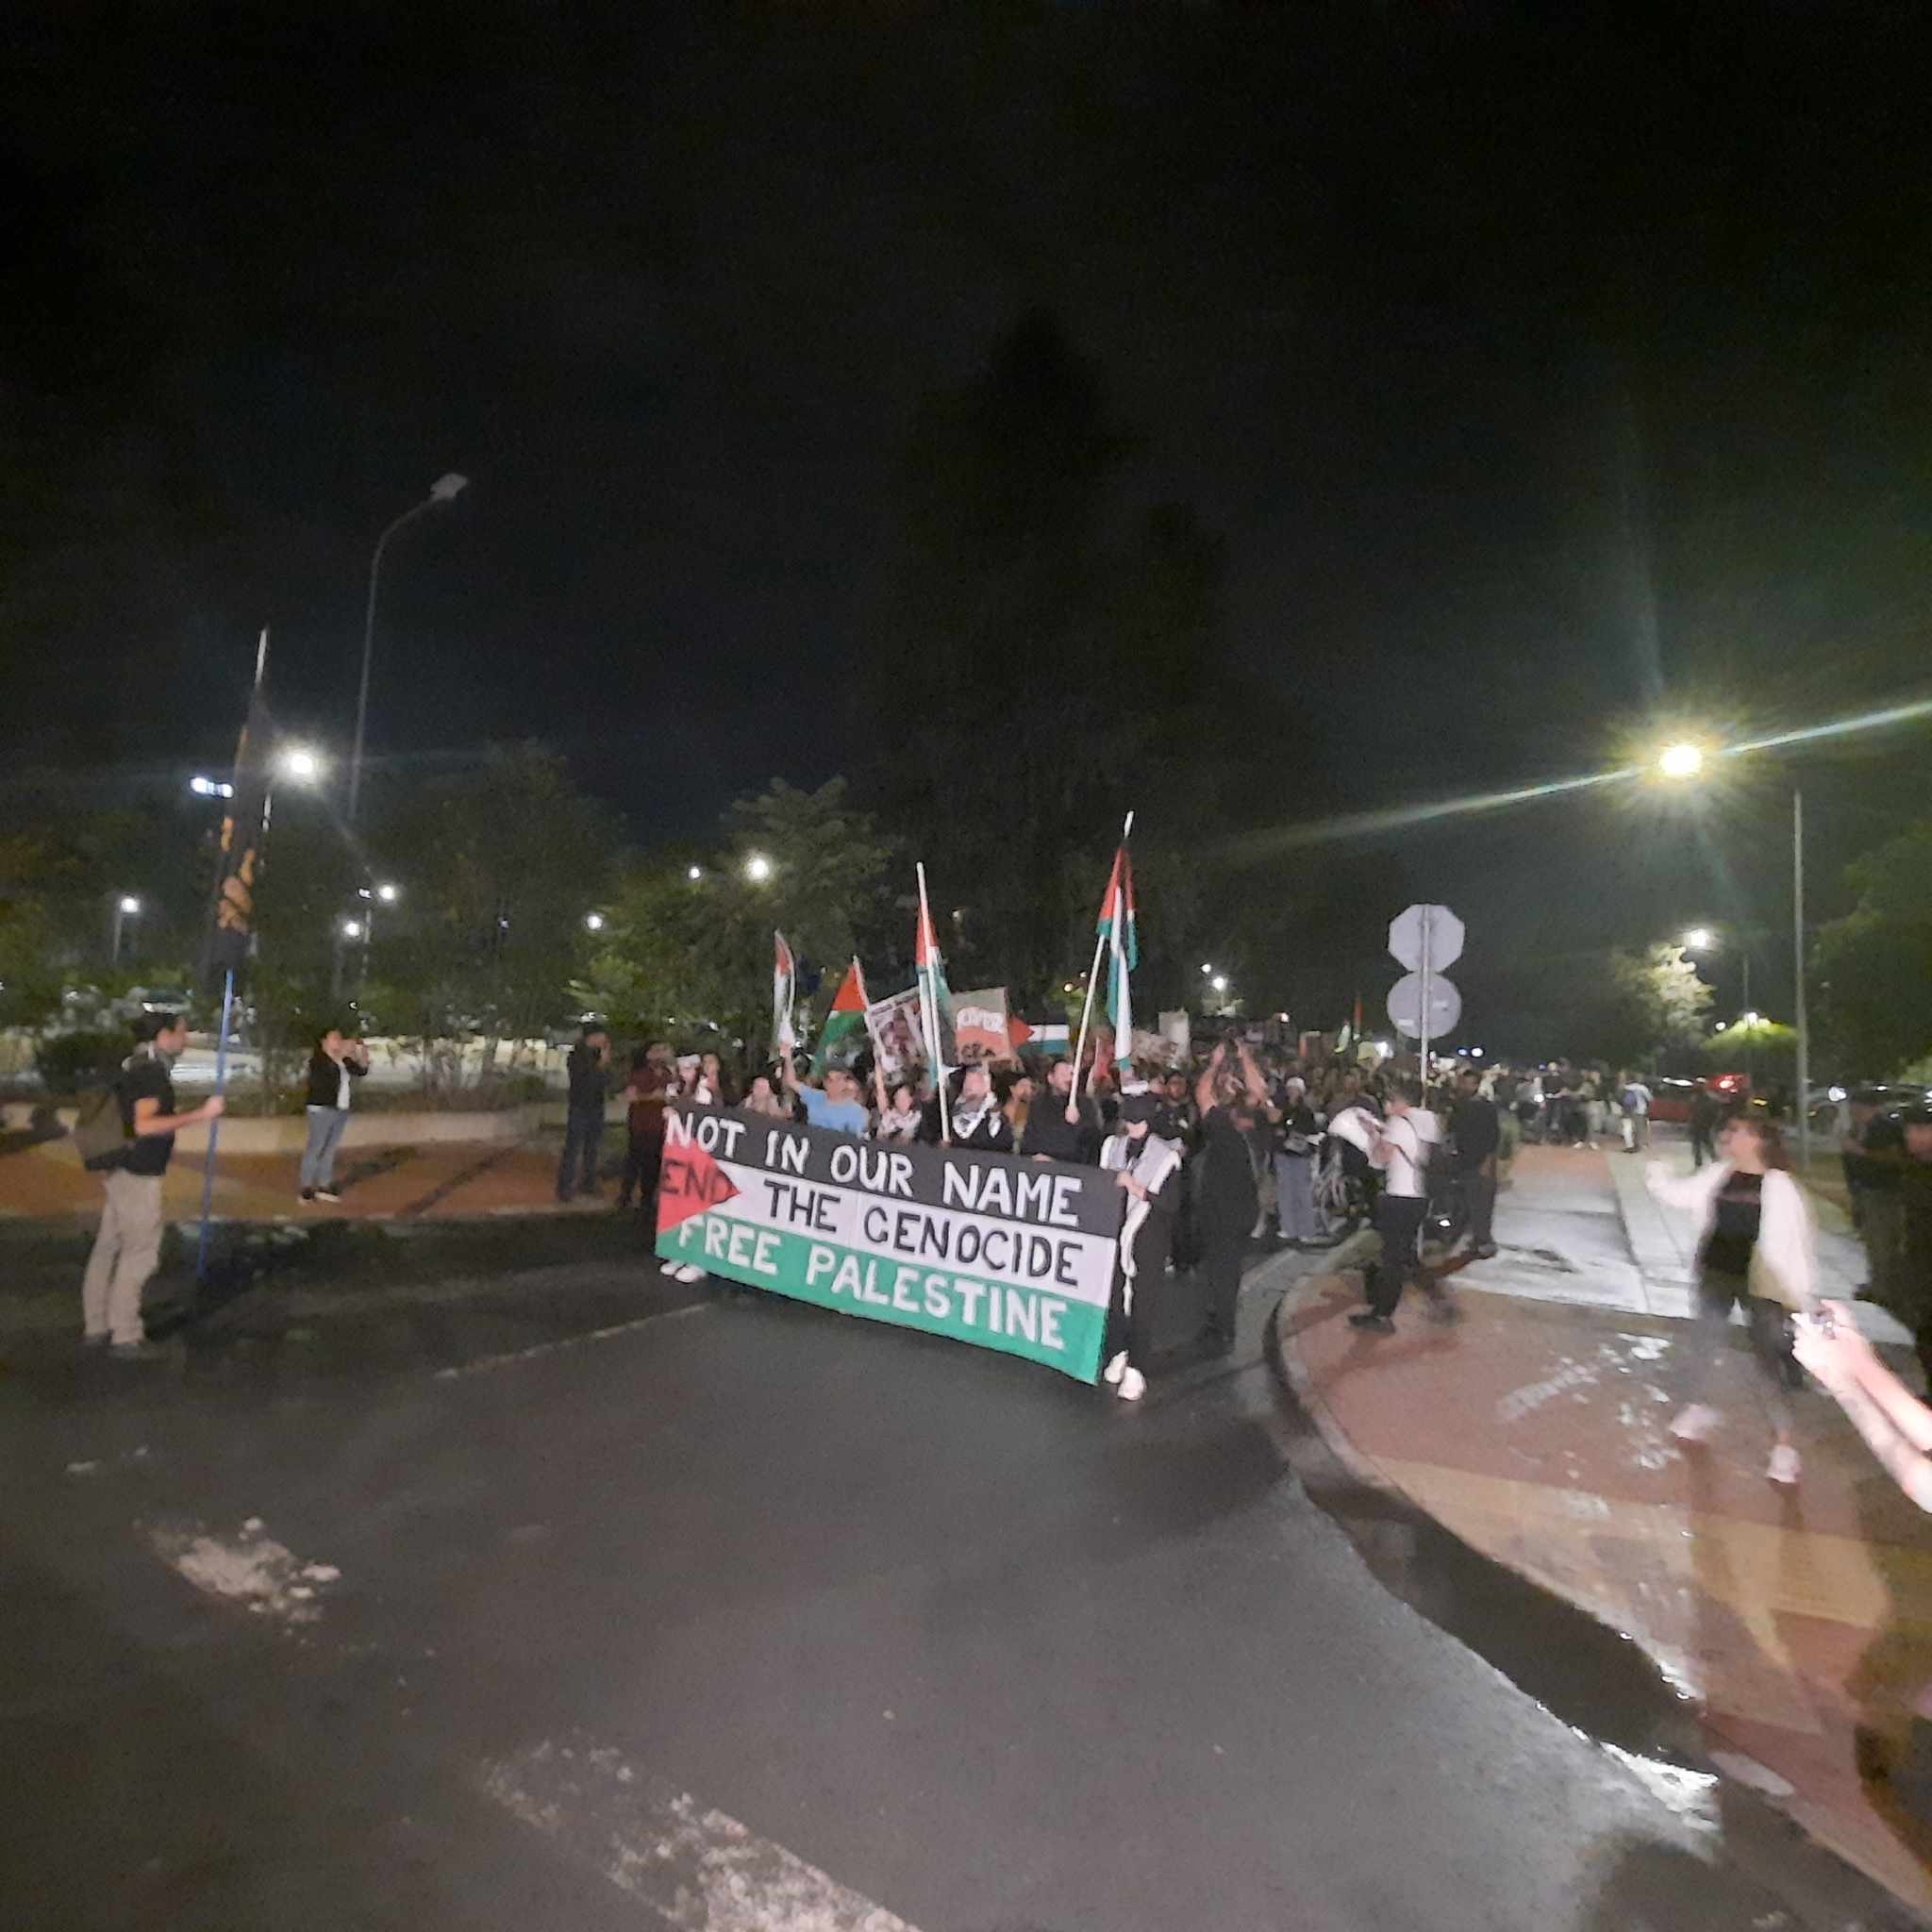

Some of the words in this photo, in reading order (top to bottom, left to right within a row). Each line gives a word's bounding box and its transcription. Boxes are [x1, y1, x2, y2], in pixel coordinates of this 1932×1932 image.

[665, 1112, 746, 1158] NOT
[765, 1130, 809, 1174] IN
[829, 1144, 914, 1197] OUR
[944, 1159, 1083, 1226] NAME
[678, 1215, 781, 1275] FREE
[805, 1250, 1069, 1351] PALESTINE
[763, 1178, 841, 1232] THE
[863, 1206, 1084, 1288] GENOCIDE
